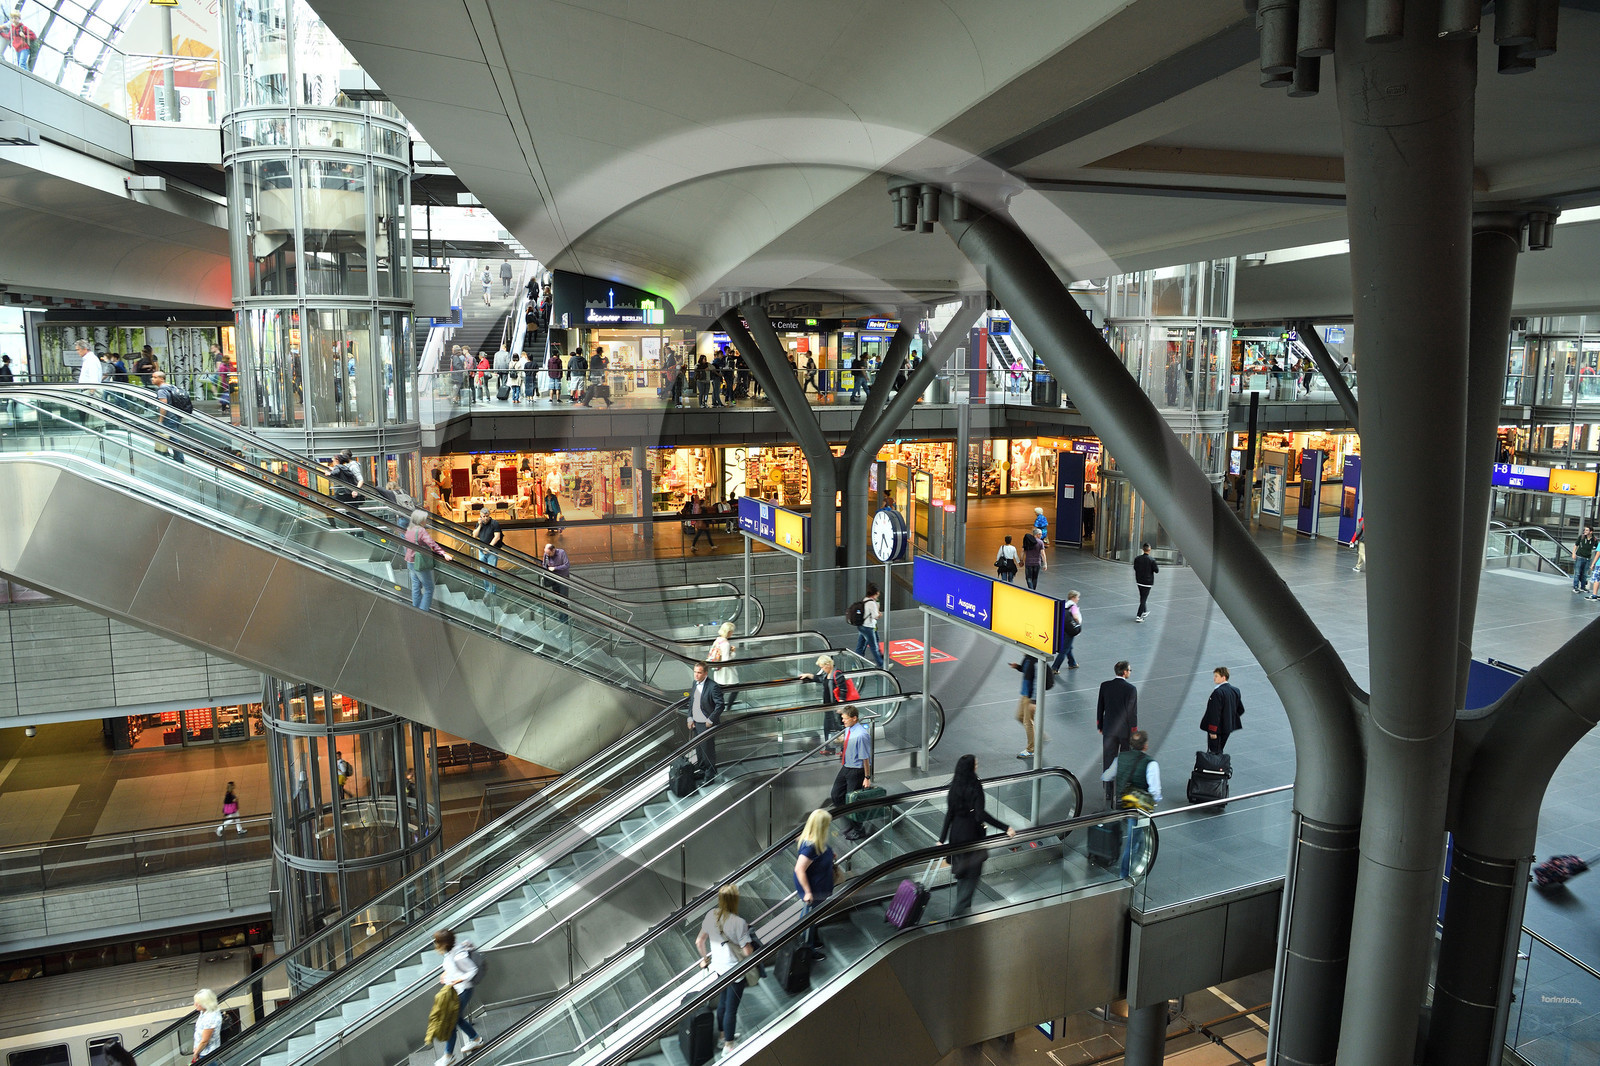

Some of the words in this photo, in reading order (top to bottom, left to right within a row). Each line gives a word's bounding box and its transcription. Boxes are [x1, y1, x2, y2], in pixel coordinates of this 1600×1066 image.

[587, 308, 620, 322] discover
[1288, 330, 1296, 339] 12
[1493, 463, 1508, 474] 1-8
[958, 598, 976, 612] Ausgang
[141, 1028, 150, 1038] 2
